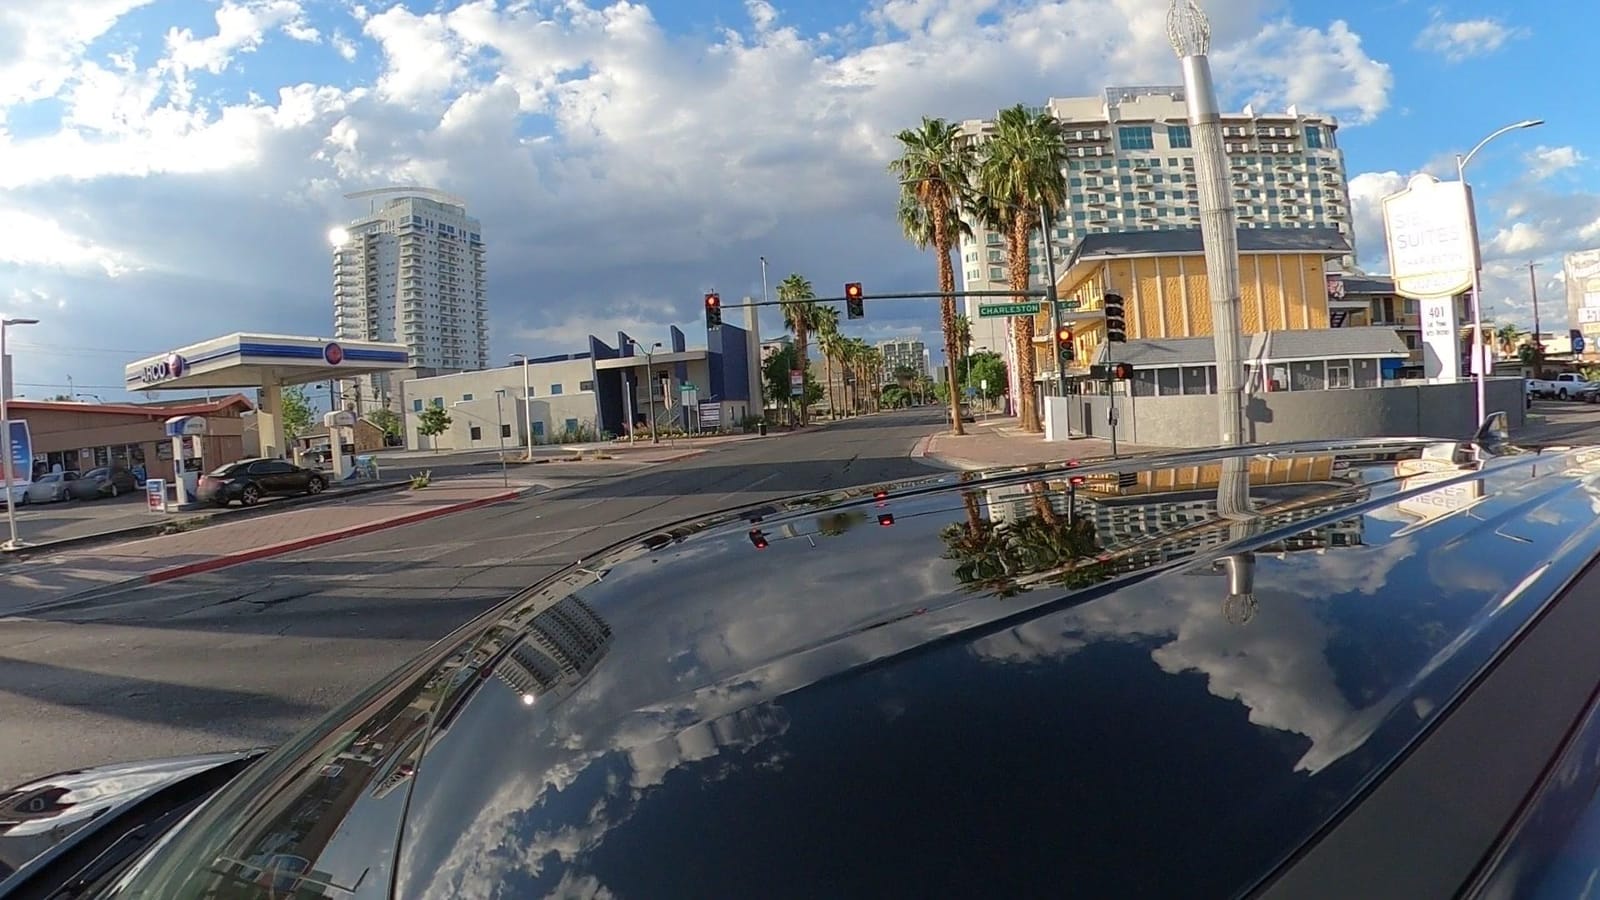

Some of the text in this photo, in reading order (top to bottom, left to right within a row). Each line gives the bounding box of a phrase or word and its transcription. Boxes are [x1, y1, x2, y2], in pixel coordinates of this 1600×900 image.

[1397, 227, 1460, 249] SUITES
[981, 304, 1039, 315] CHARLESTON
[1429, 306, 1444, 318] 401
[141, 363, 166, 382] ARCO
